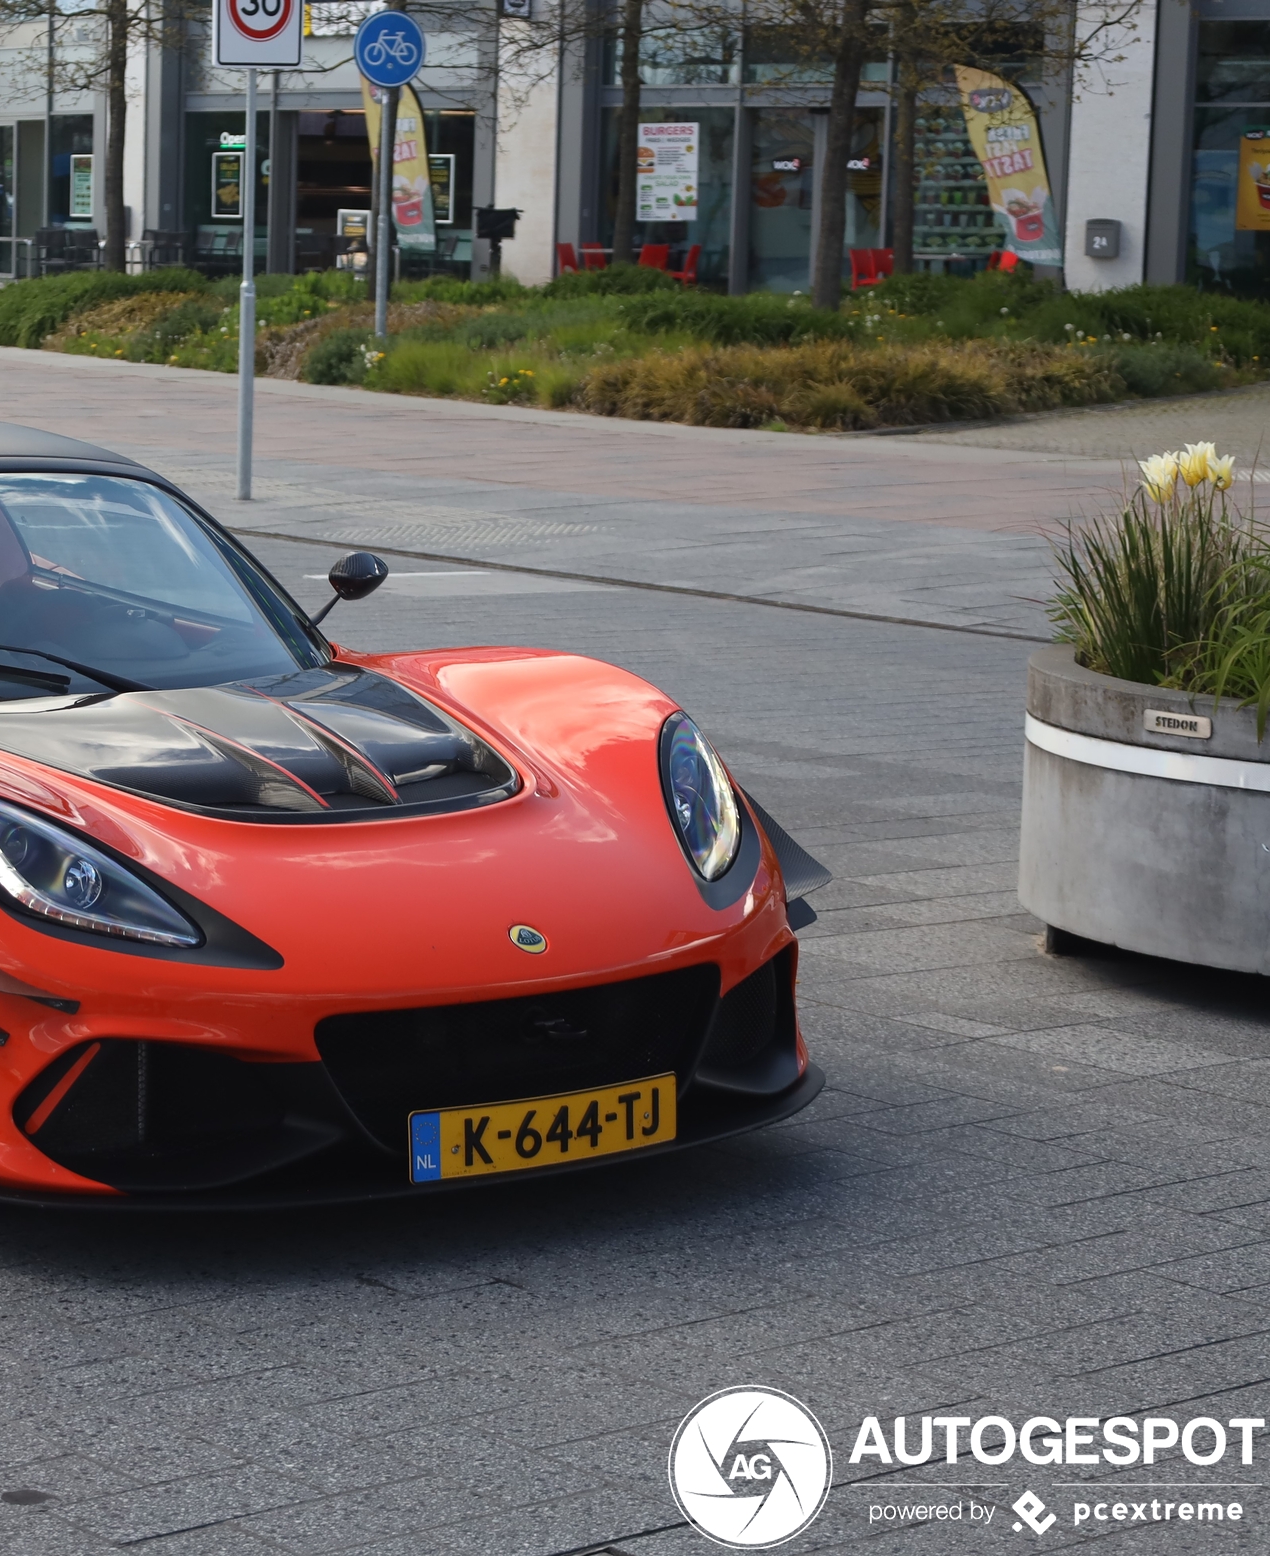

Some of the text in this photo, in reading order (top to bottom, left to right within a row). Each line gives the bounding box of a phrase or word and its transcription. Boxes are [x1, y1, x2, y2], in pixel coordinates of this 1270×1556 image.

[241, 0, 281, 16] 30
[643, 126, 694, 136] BURGERS
[1093, 236, 1108, 249] 2A
[464, 1087, 660, 1167] K-644-TJ
[416, 1154, 436, 1170] NL
